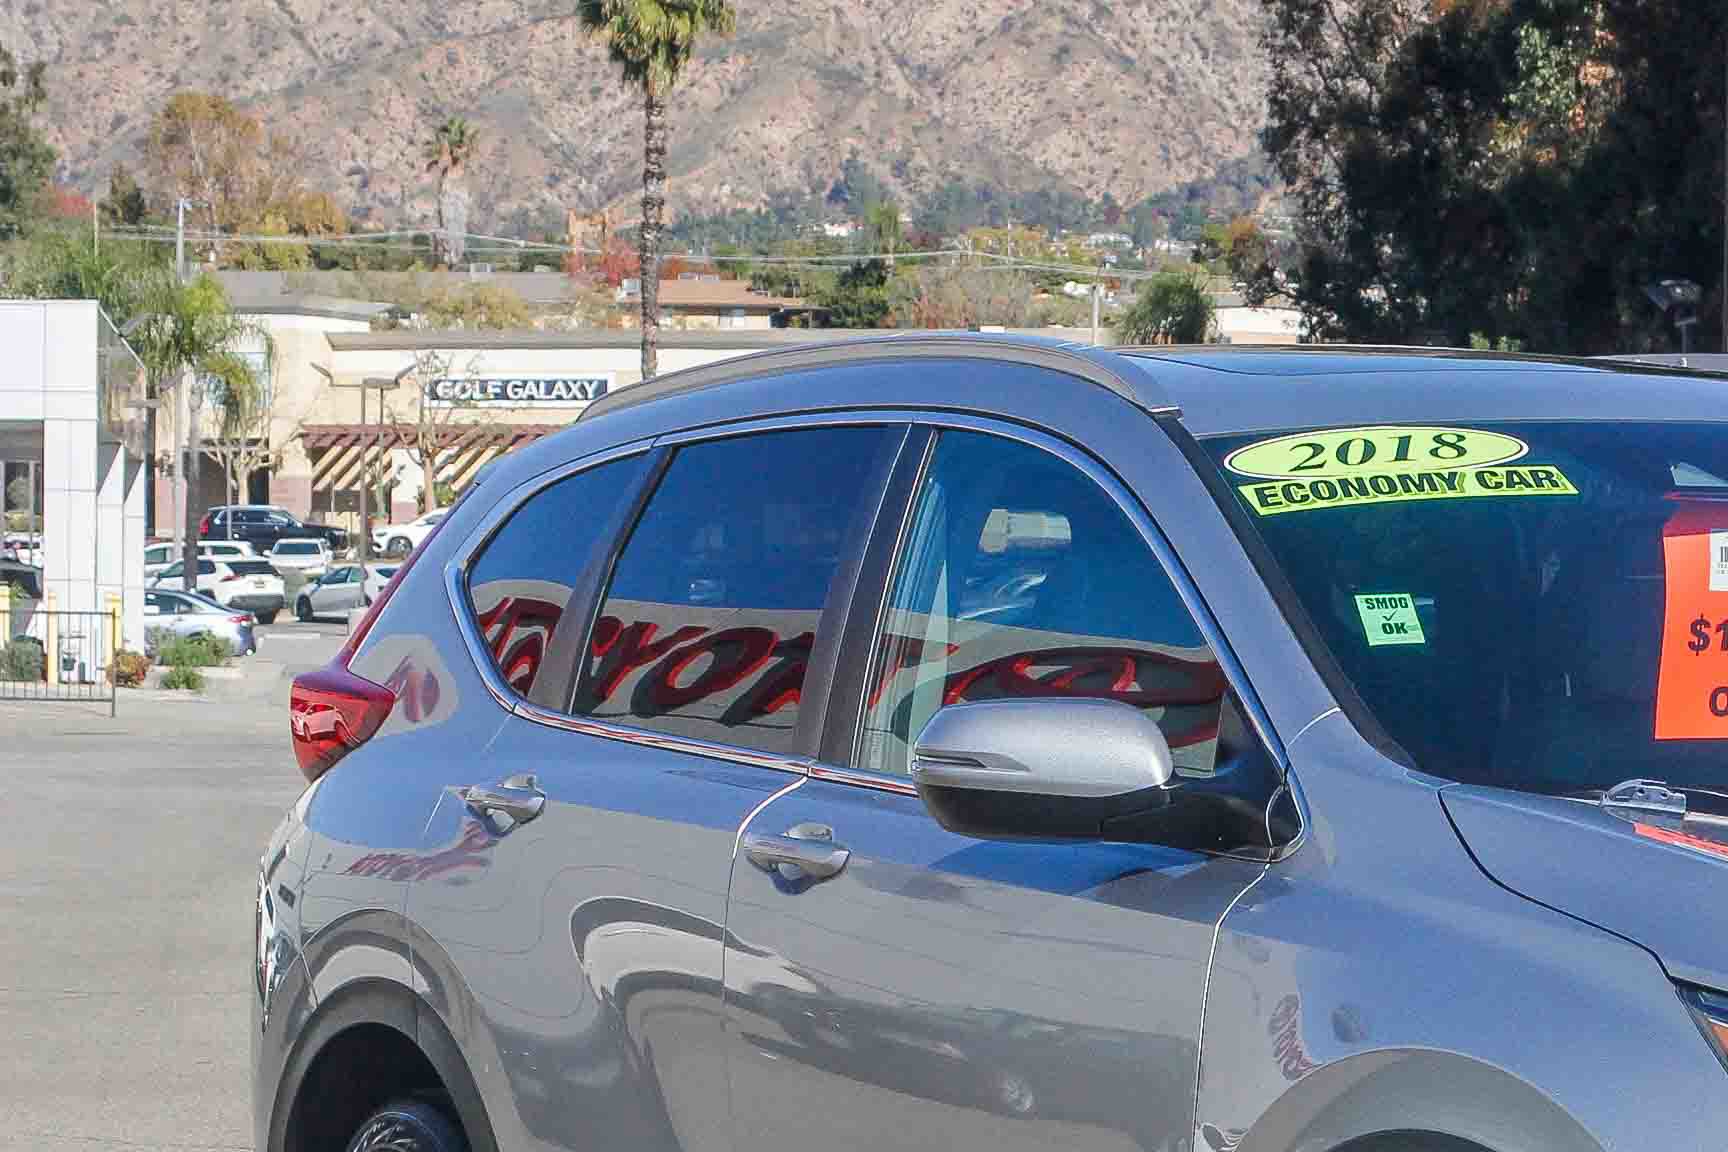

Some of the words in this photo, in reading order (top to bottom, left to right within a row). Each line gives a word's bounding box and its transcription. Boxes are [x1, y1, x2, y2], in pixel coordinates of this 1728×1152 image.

[435, 380, 502, 401] GOLF
[506, 380, 599, 400] GALAXY
[1287, 432, 1469, 473] 2018
[1254, 470, 1466, 508] ECONOMY
[1475, 468, 1567, 491] CAR
[1365, 596, 1409, 610] SMOG
[1381, 622, 1408, 635] OK
